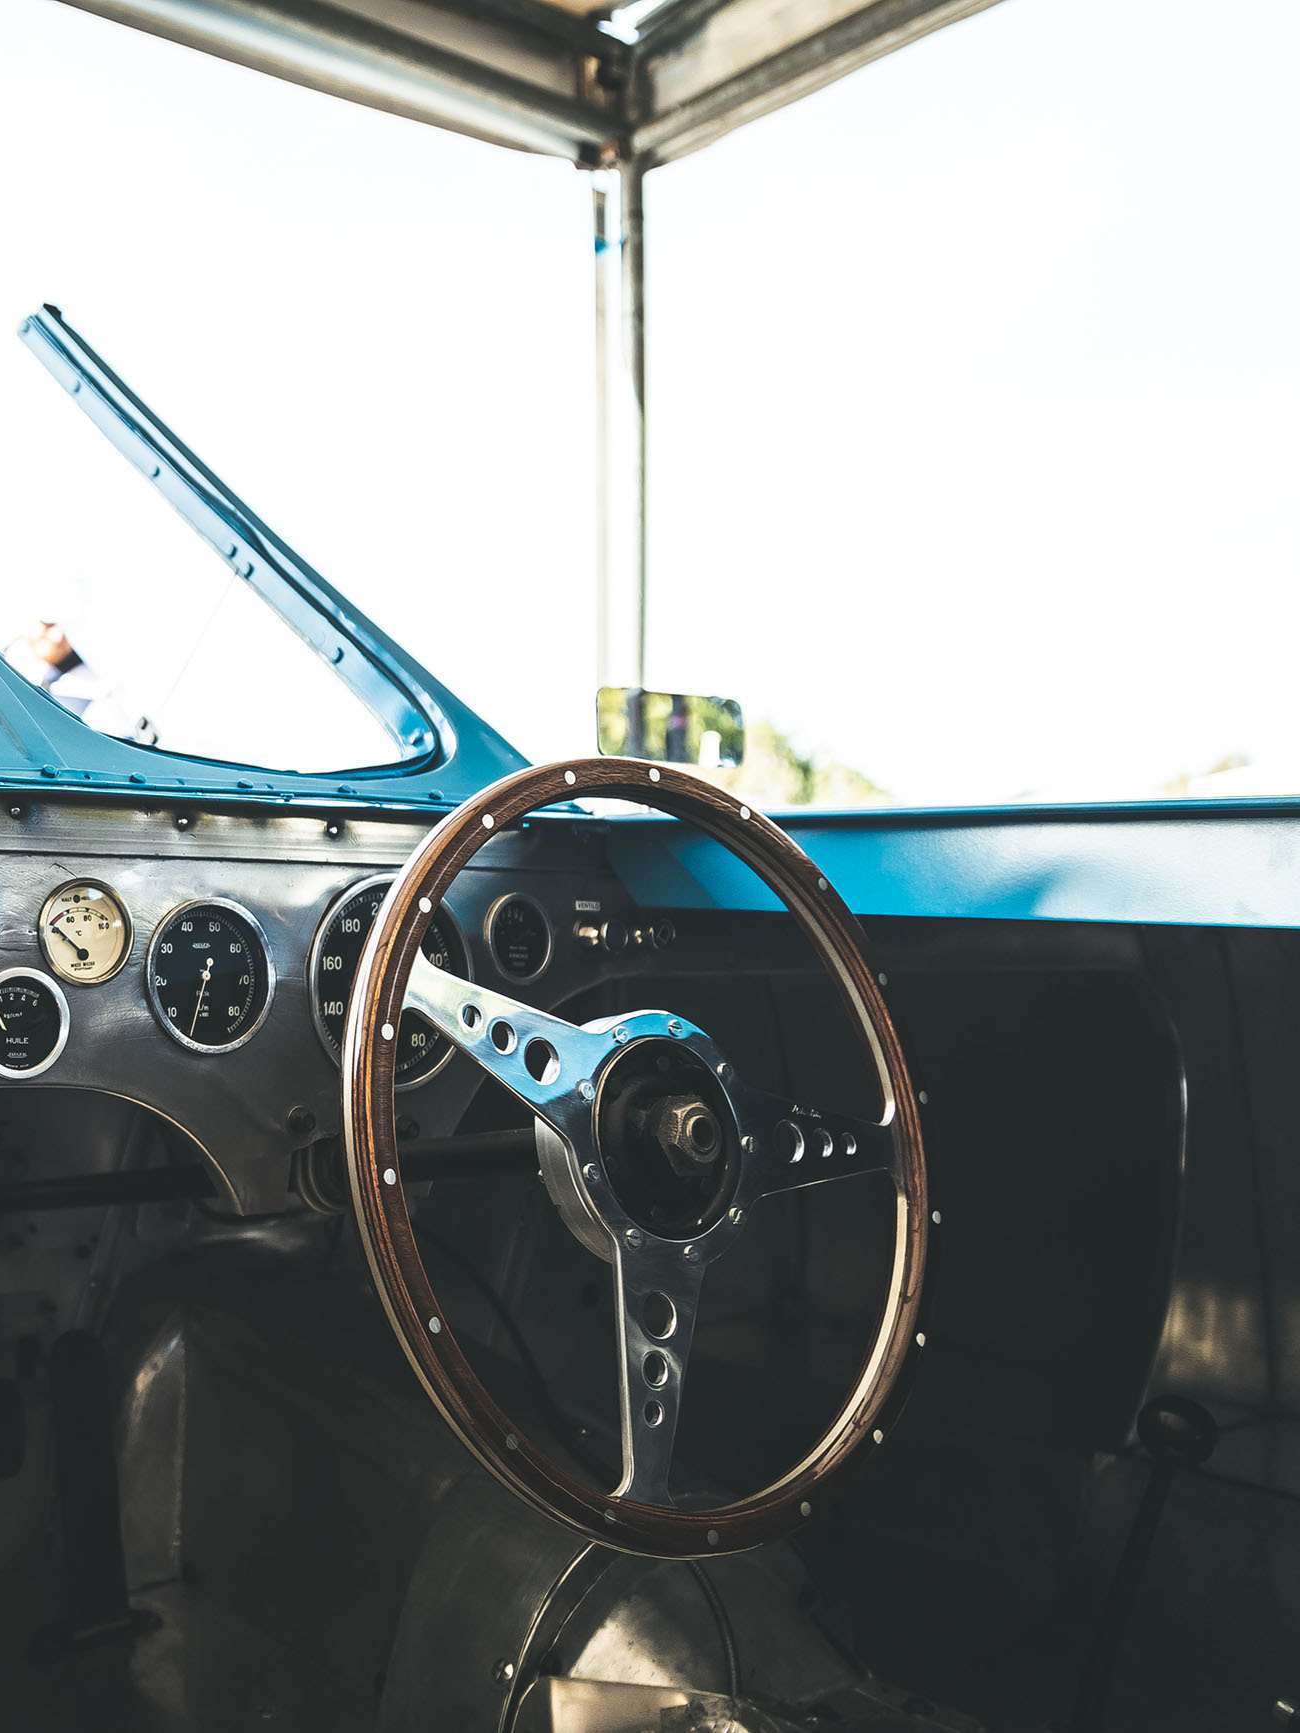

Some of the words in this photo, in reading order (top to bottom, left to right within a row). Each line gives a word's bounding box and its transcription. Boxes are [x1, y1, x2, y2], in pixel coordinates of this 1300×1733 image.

[181, 921, 193, 932] 40
[208, 921, 221, 932] 50
[341, 918, 360, 932] 180
[161, 943, 173, 954] 30
[229, 943, 241, 953] 60
[322, 956, 342, 970] 160
[167, 1007, 177, 1017] 10
[228, 1006, 240, 1016] 80
[323, 1001, 343, 1015] 140
[411, 1034, 426, 1047] 80
